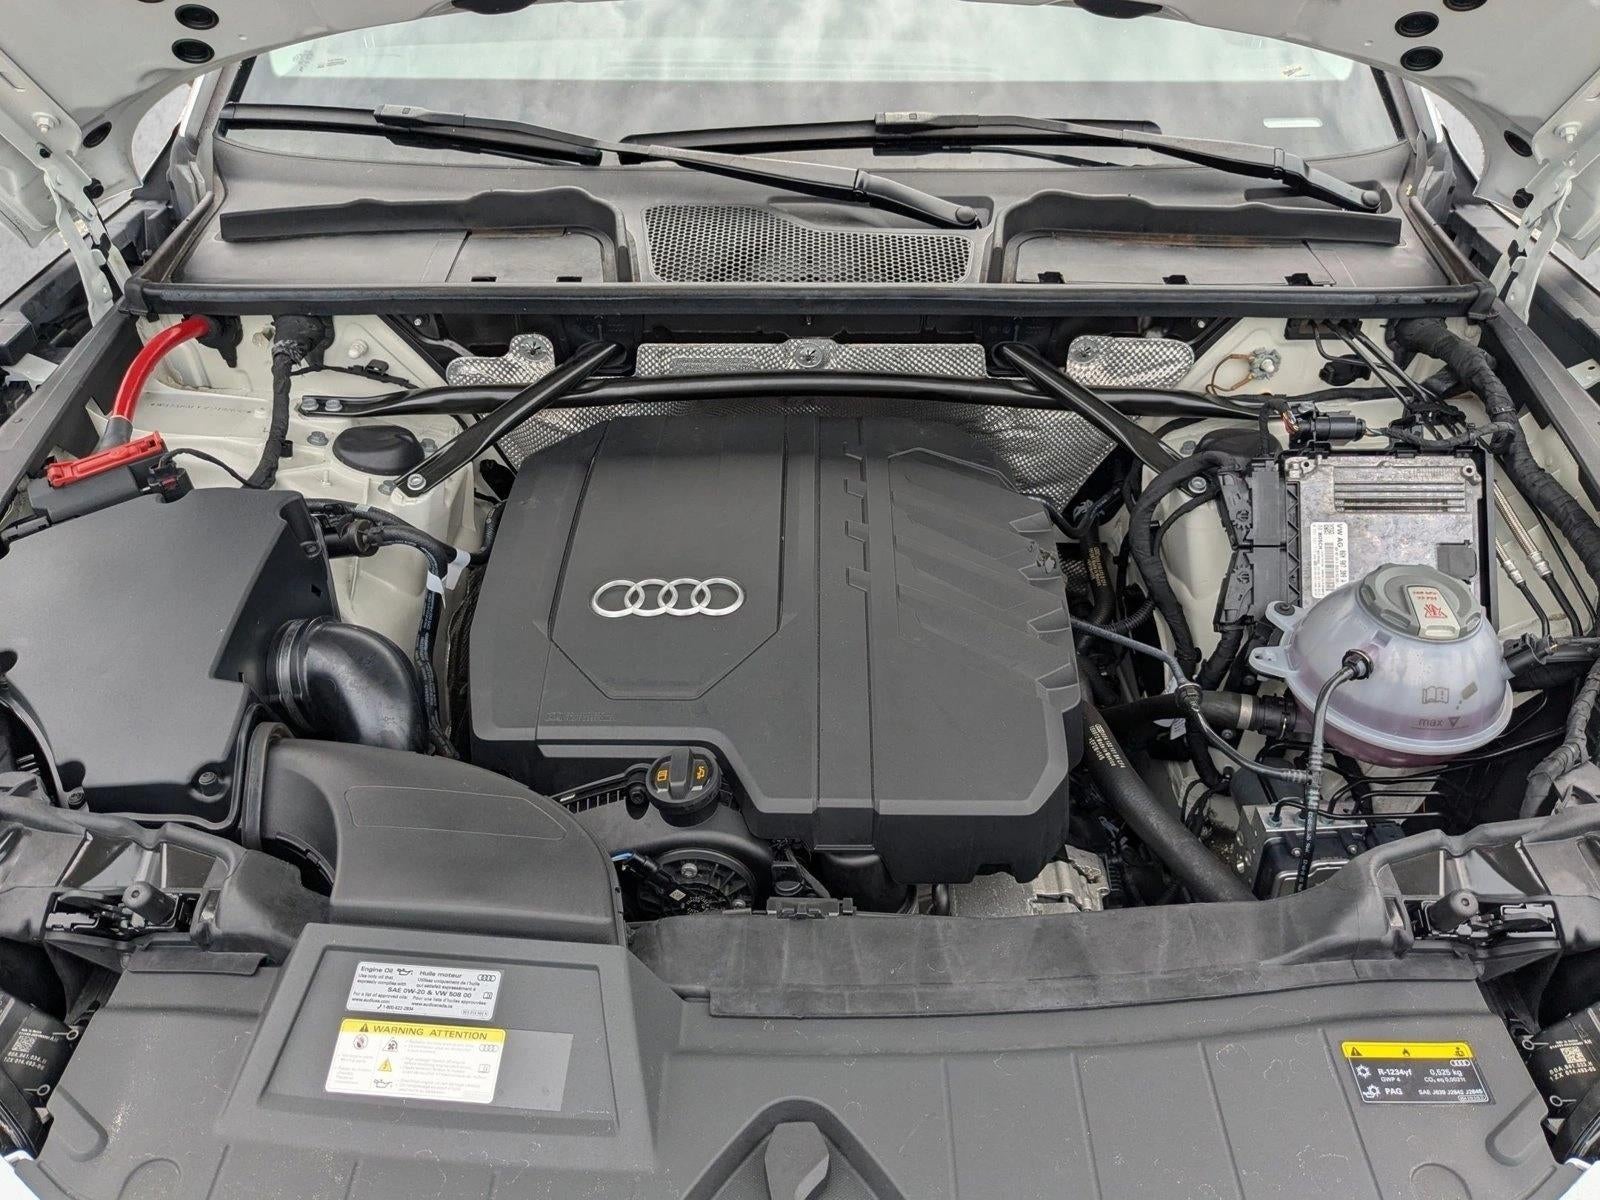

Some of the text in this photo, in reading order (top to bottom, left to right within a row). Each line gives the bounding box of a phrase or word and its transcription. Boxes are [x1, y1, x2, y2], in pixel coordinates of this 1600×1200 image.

[1336, 524, 1344, 536] VW
[1336, 537, 1344, 548] AG
[1418, 718, 1444, 727] max
[360, 966, 383, 974] Engine
[373, 1024, 424, 1036] WARNING
[429, 1030, 488, 1040] ATTENTION
[1377, 1068, 1412, 1077] R-1234yf
[1452, 1068, 1463, 1077] kg
